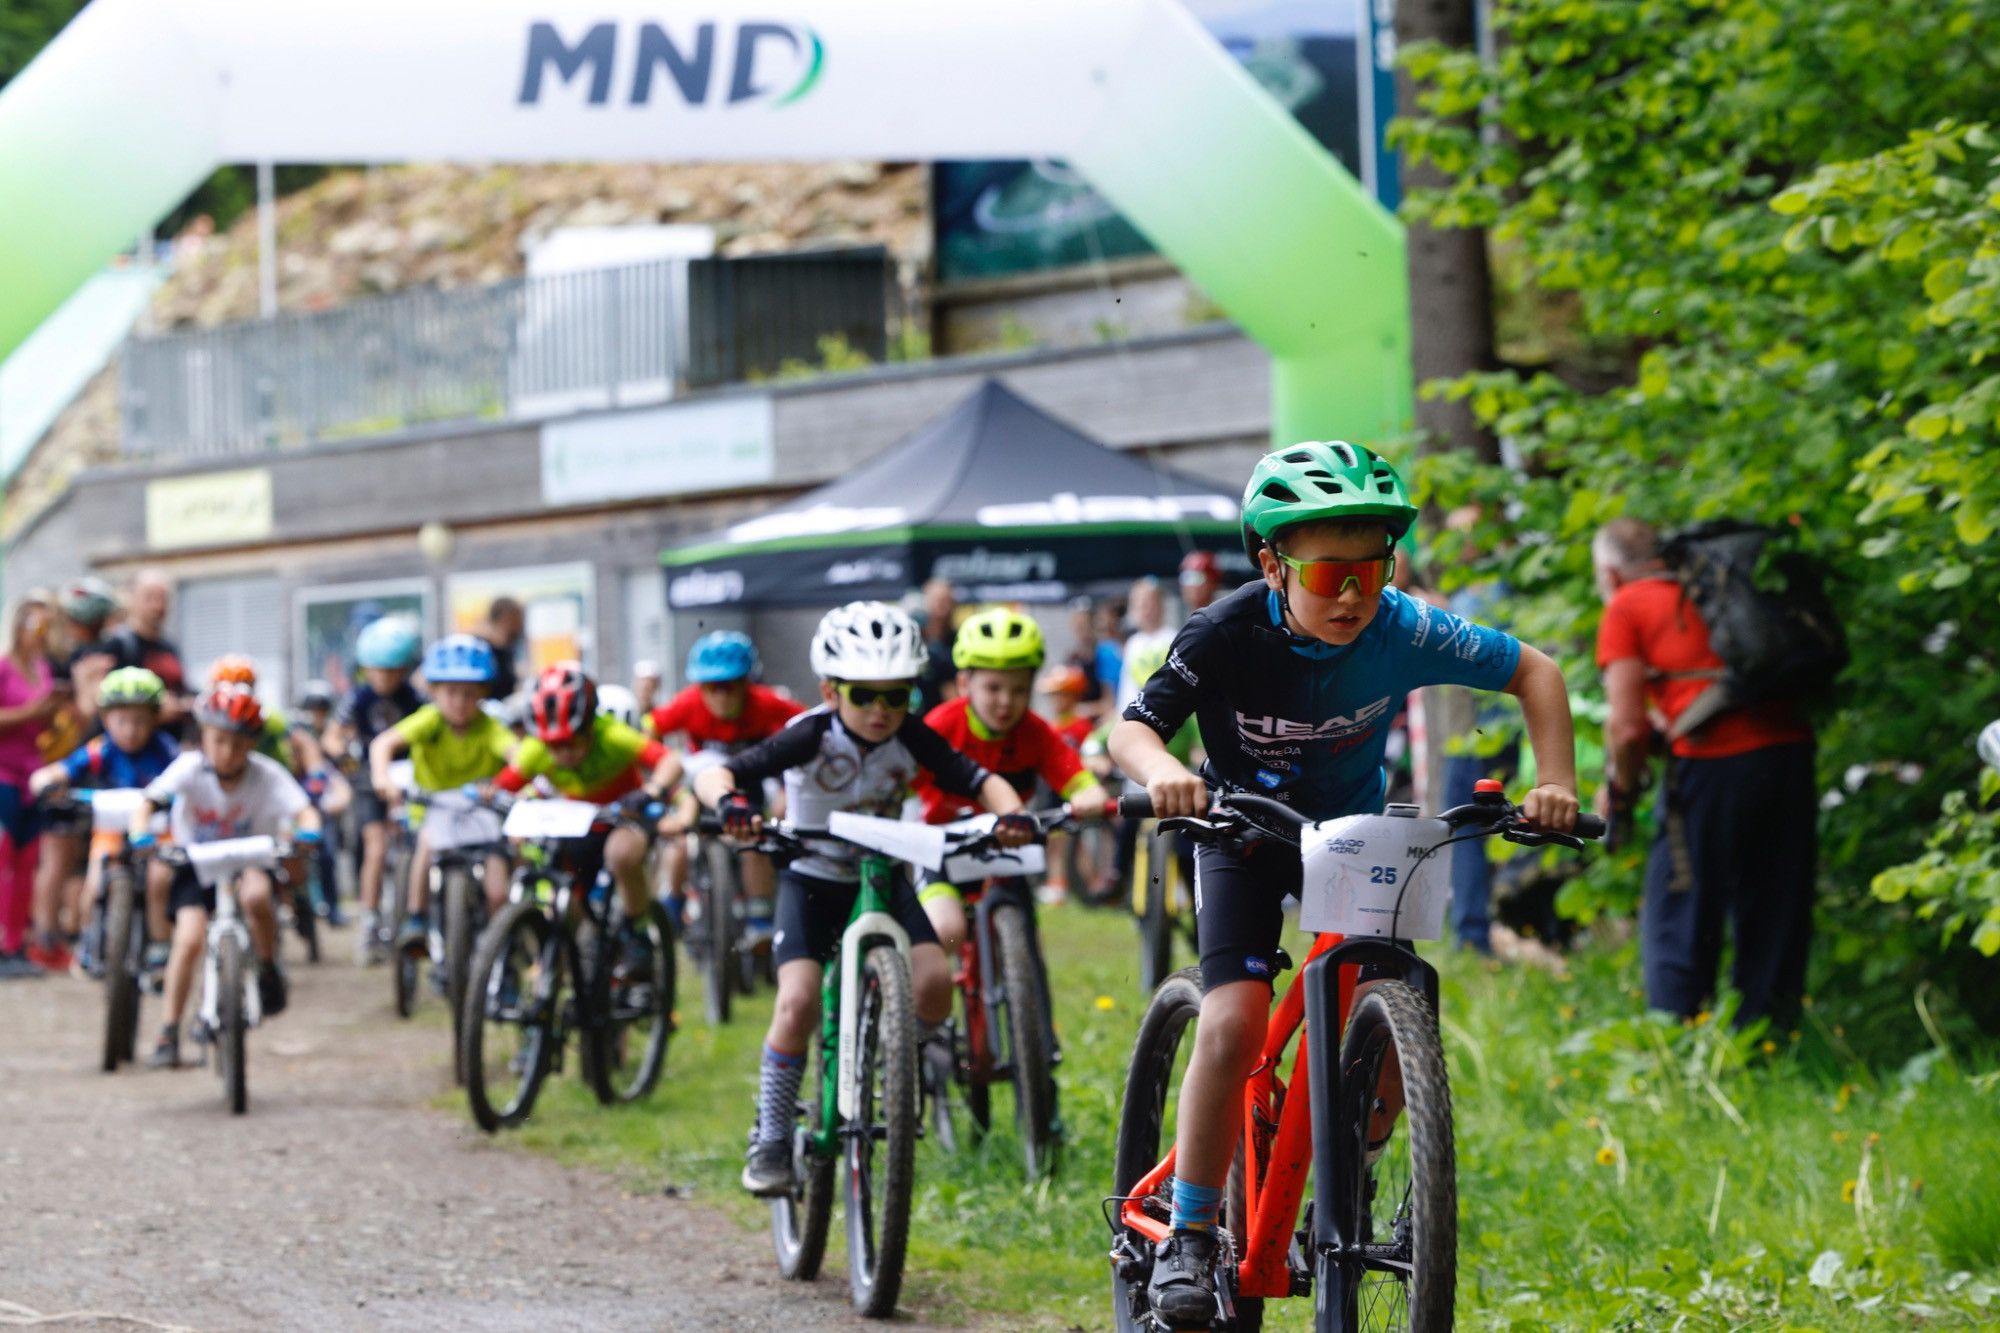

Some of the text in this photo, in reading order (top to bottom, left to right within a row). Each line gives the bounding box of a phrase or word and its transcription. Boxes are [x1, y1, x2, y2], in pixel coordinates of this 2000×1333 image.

[517, 22, 826, 107] MND
[1235, 696, 1391, 736] HEAD
[1370, 866, 1397, 885] 25
